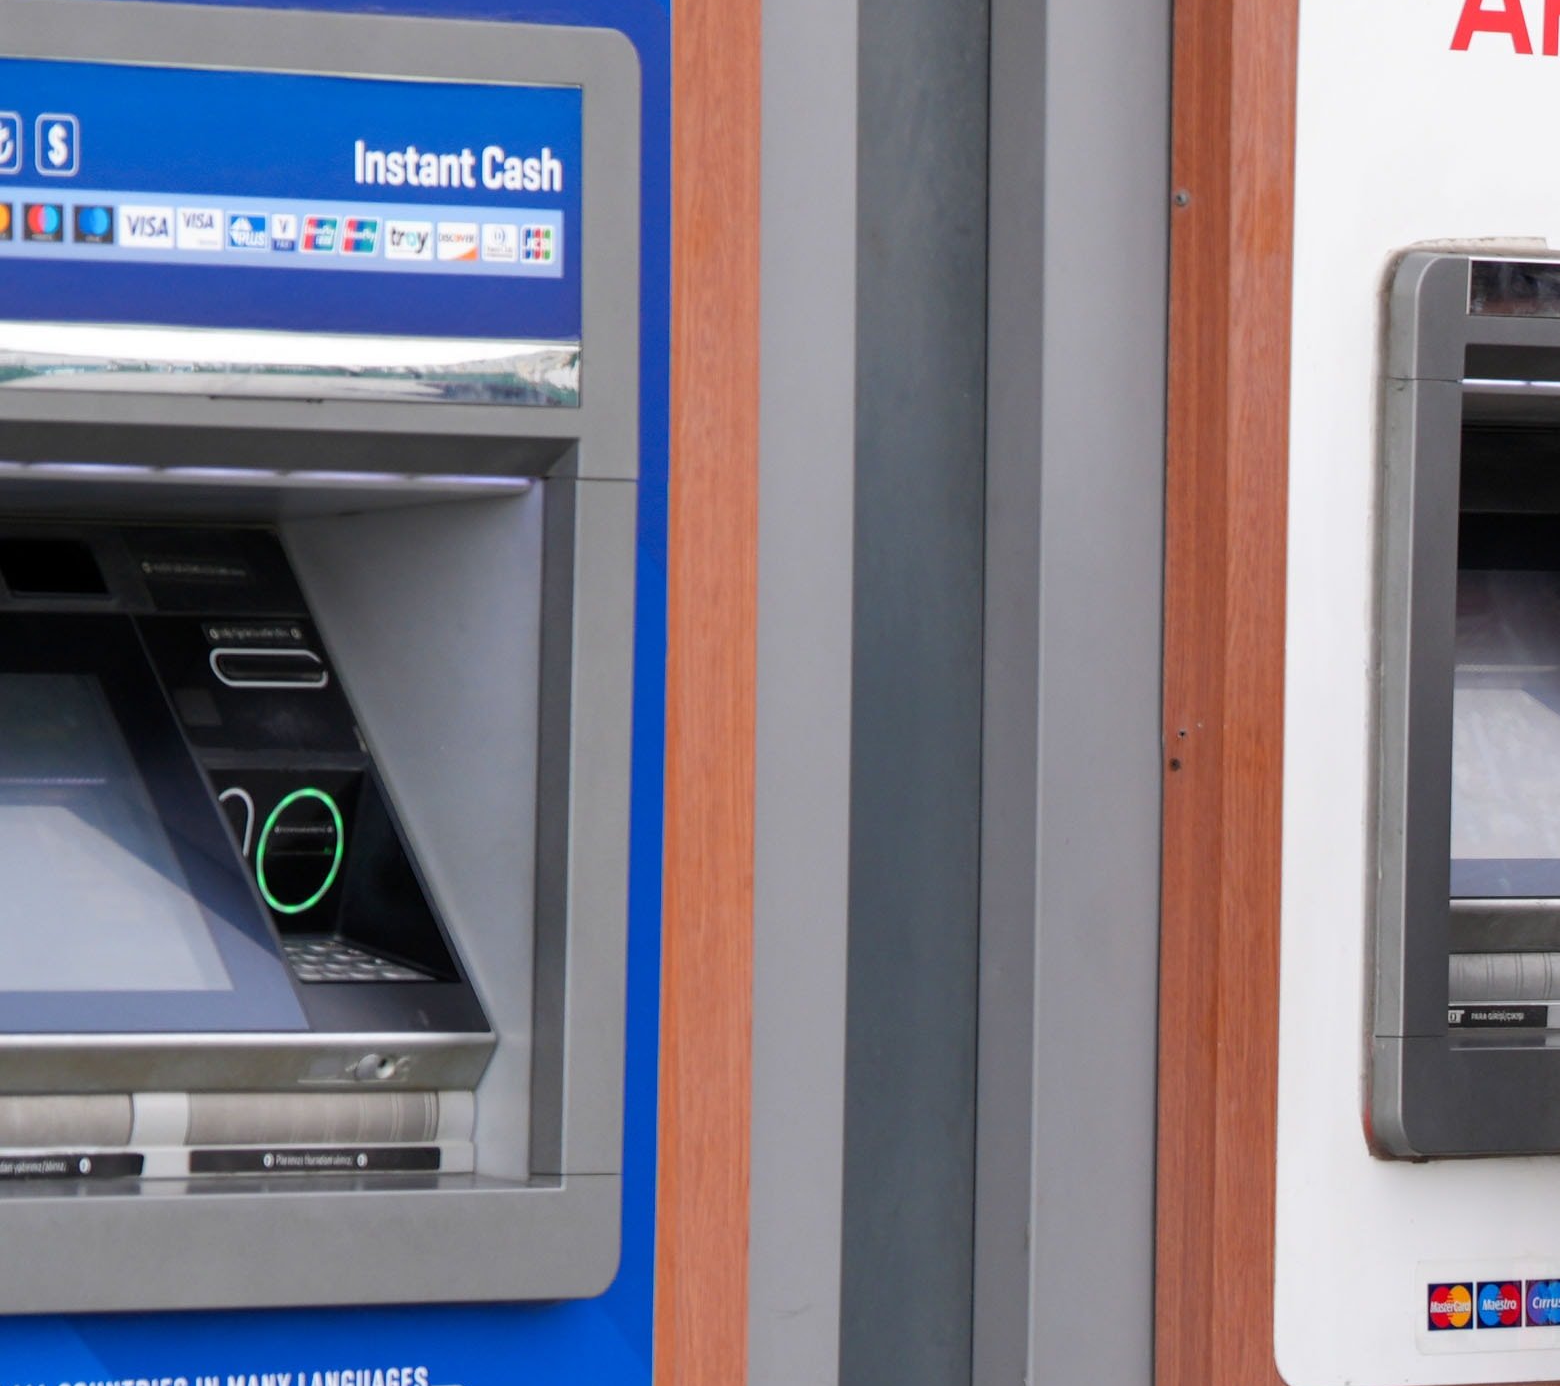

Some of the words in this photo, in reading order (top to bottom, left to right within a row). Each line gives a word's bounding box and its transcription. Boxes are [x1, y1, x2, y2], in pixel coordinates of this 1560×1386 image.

[354, 140, 476, 188] Instant
[482, 145, 562, 192] Cash
[128, 215, 168, 238] VISA
[183, 212, 213, 229] VISA
[391, 226, 428, 253] troy
[1430, 1300, 1471, 1314] MasterCard
[1482, 1298, 1517, 1311] Maestro
